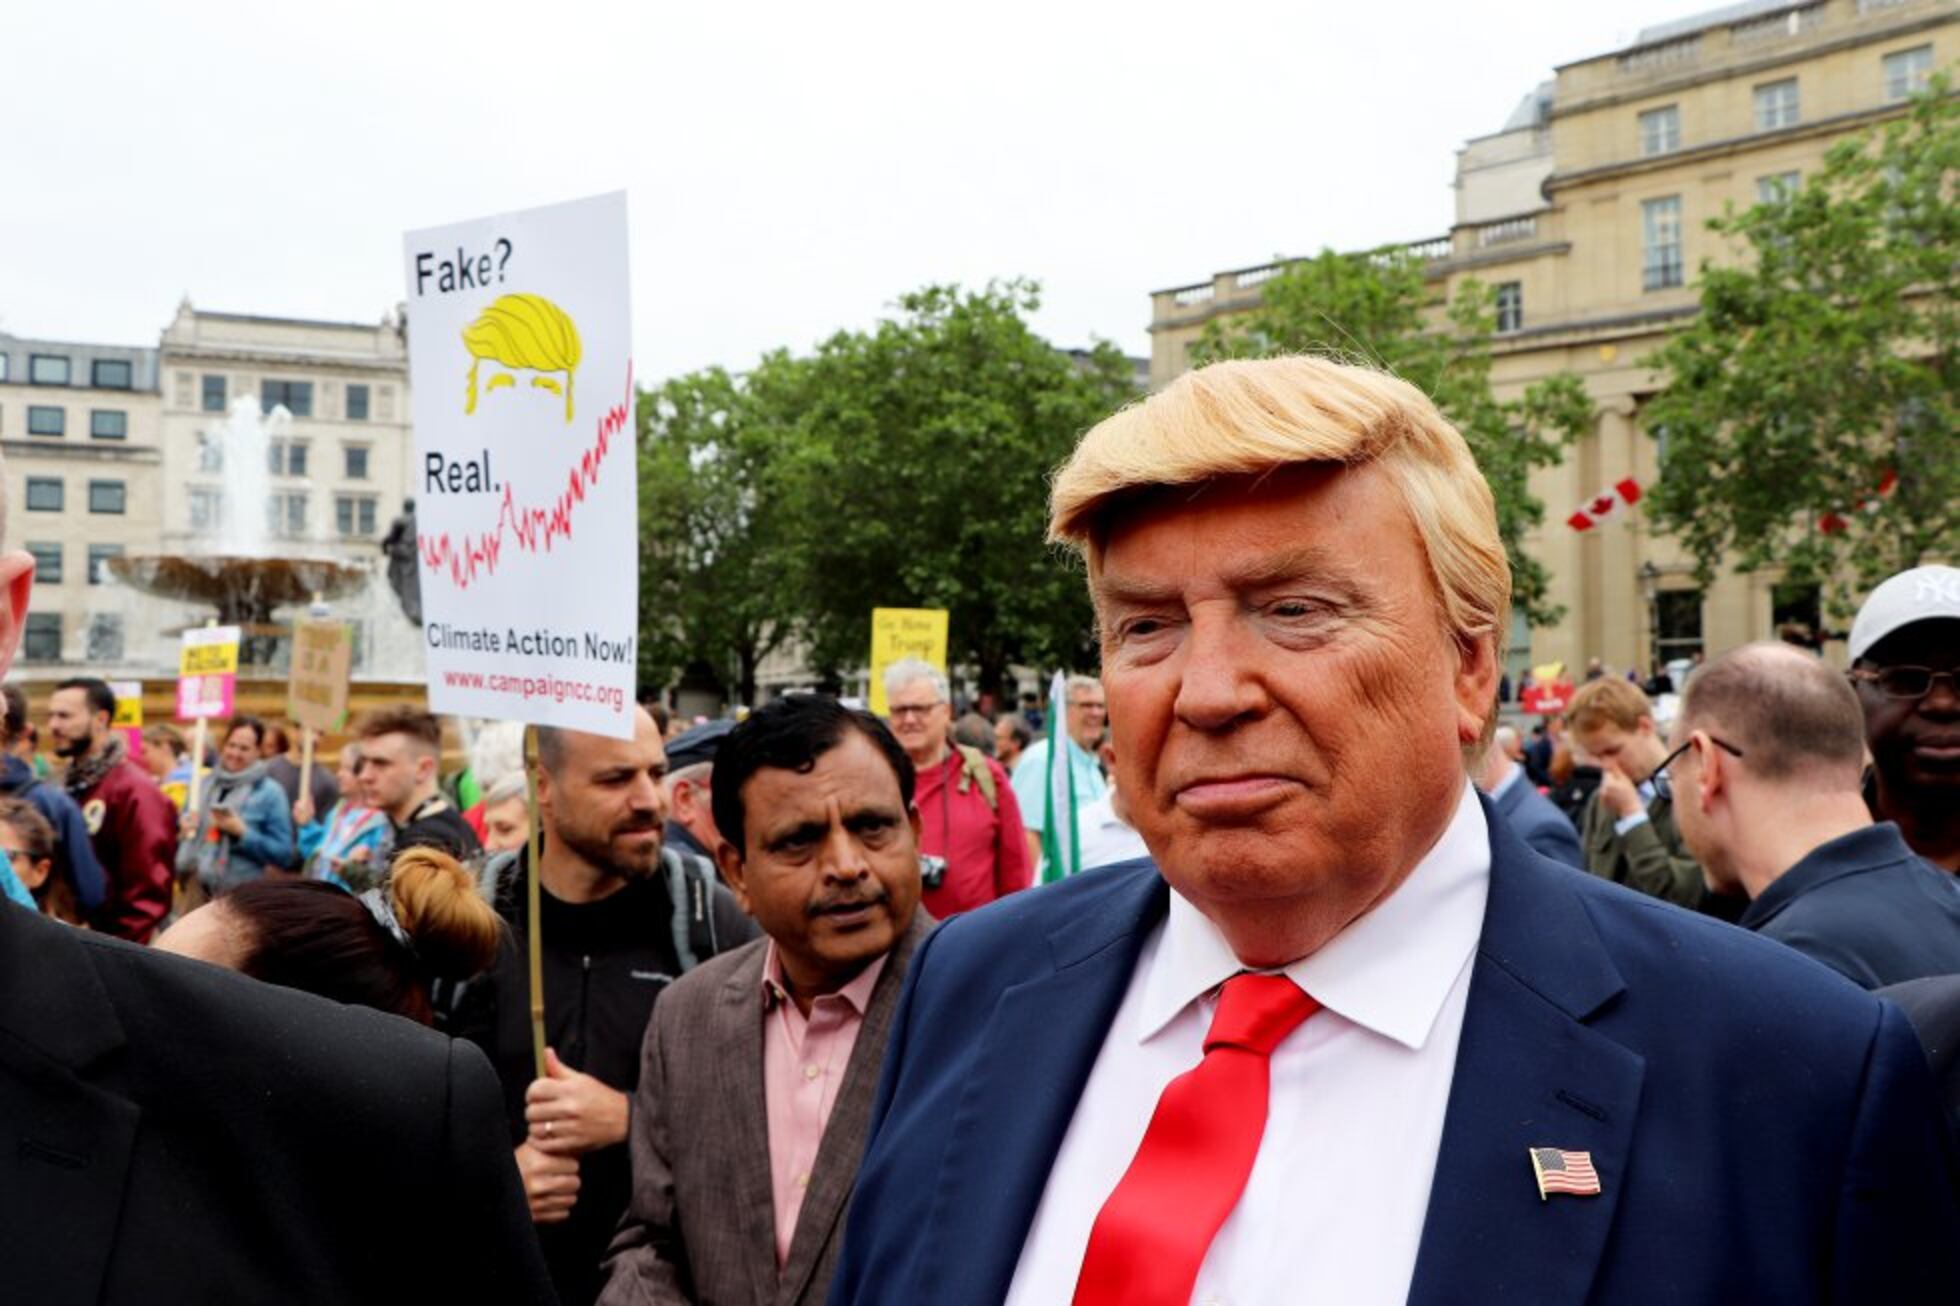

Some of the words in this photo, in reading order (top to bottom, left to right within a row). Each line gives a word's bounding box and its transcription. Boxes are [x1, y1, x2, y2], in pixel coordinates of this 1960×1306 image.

[415, 237, 512, 296] Fake?
[425, 449, 500, 494] Real.
[427, 622, 500, 653] Climate
[506, 628, 578, 659] Action
[585, 632, 633, 664] Now!
[443, 669, 624, 713] www.campaigncc.org
